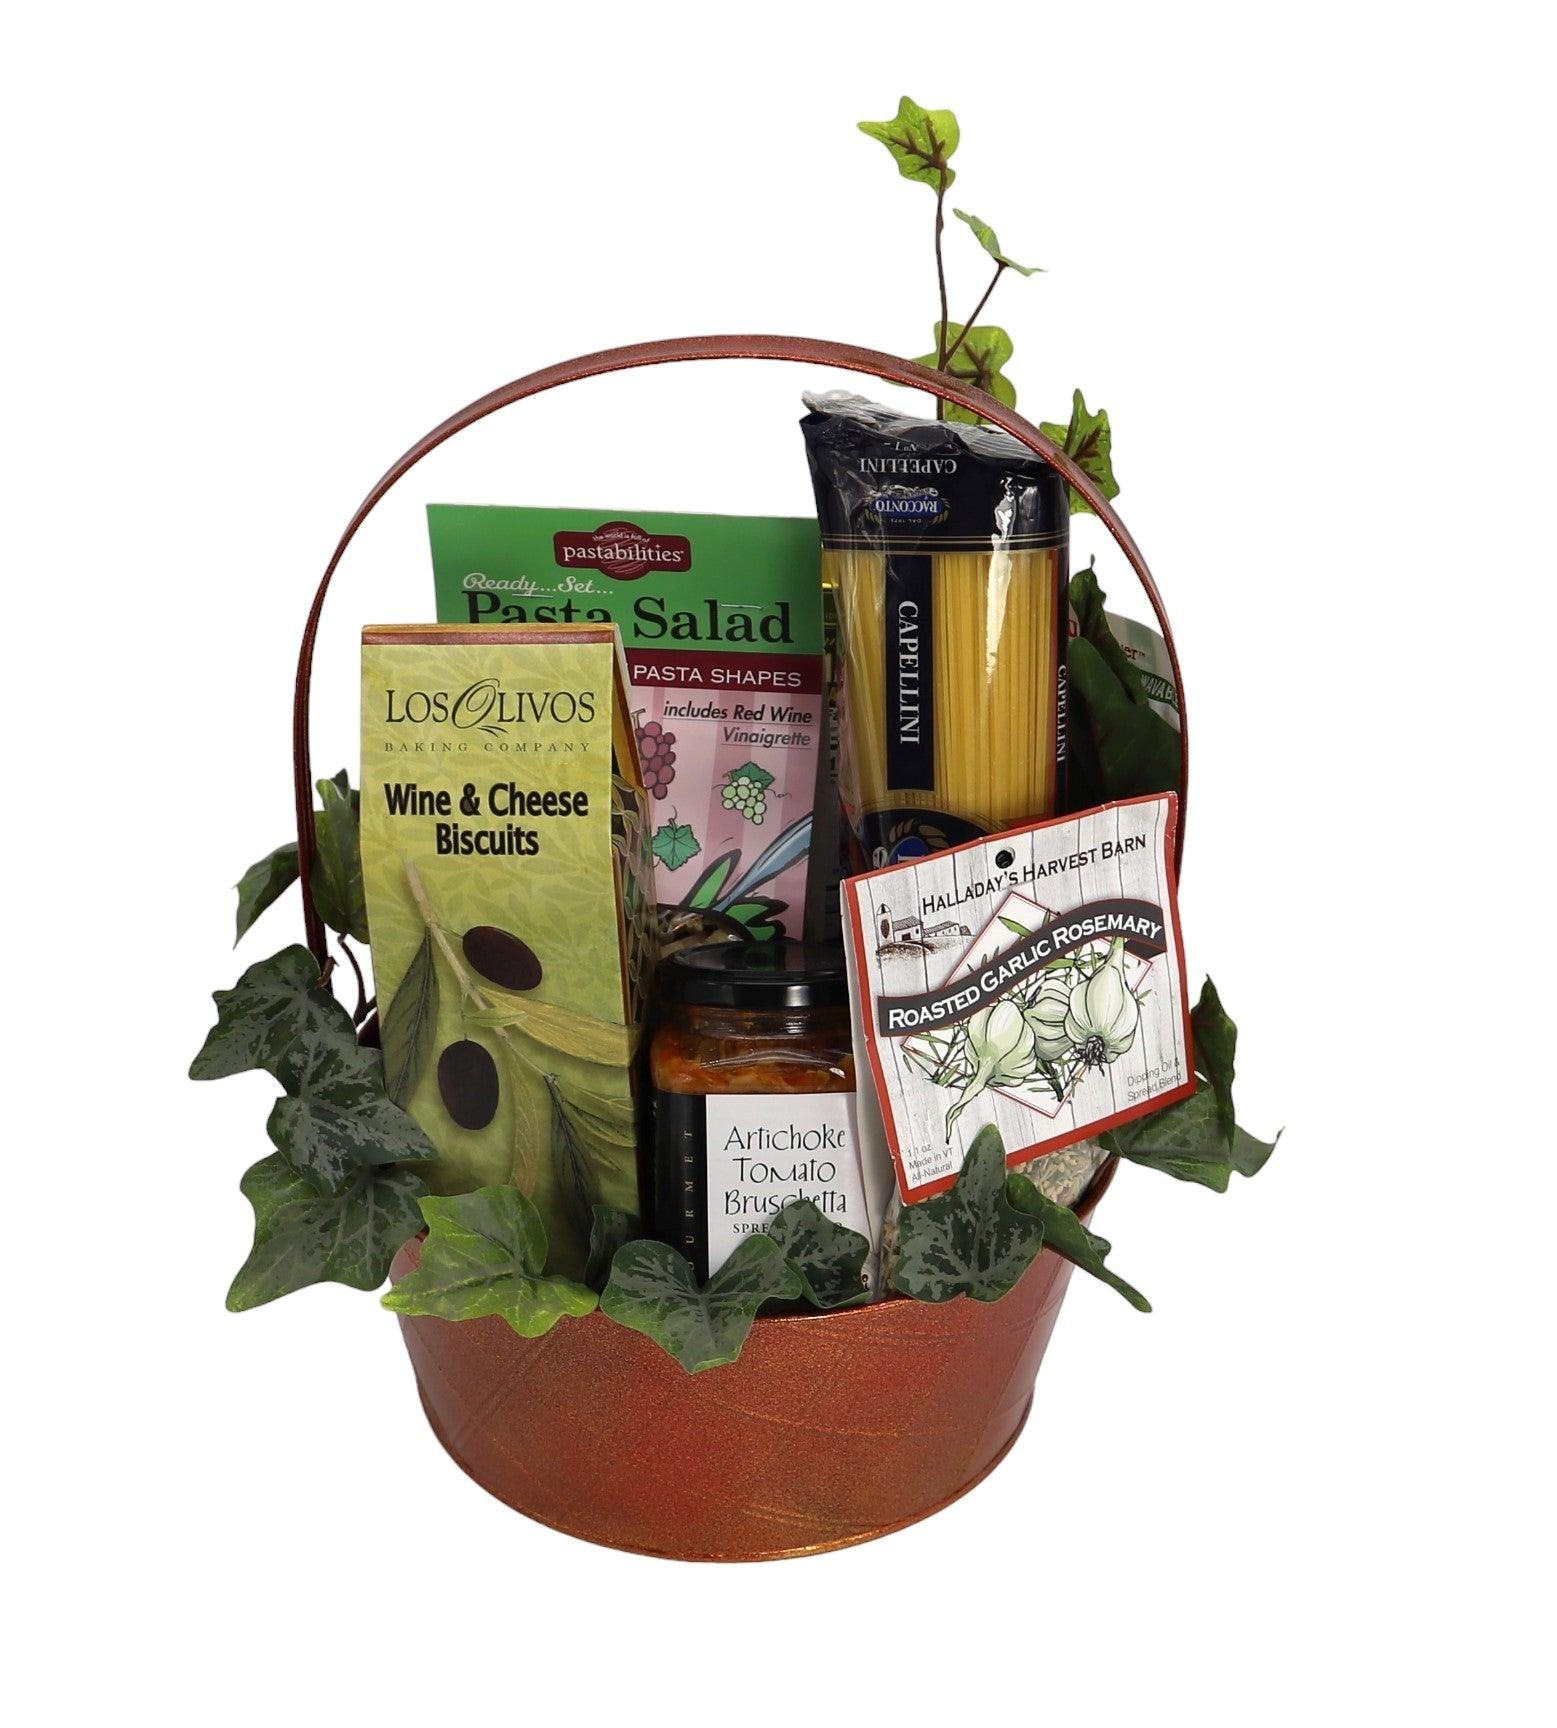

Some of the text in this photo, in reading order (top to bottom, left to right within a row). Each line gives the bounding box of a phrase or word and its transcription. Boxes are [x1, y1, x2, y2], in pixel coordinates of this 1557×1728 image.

[859, 458, 958, 474] CAPELLINI
[875, 500, 938, 514] RACCONTO
[563, 543, 682, 562] pastabilities
[633, 596, 795, 644] Salad
[633, 665, 801, 687] PASTA SHAPES
[898, 600, 920, 744] CAPELLINI
[663, 700, 813, 724] includes Red Wine
[1057, 664, 1066, 762] CAPELLINI
[385, 742, 590, 752] BAKING COMPANY
[723, 726, 811, 748] Vinaigrette
[384, 782, 589, 817] Wine & Cheese
[436, 823, 539, 856] Biscuits
[922, 834, 1146, 915] HALLADAY'S HARVEST BARN
[888, 913, 1162, 1029] ROASTED GARLIC ROSEMARY
[1127, 1067, 1160, 1087] Dipping
[1128, 1071, 1182, 1102] Spread Blend
[723, 1123, 846, 1151] Artichoke
[909, 1157, 932, 1169] Made
[943, 1147, 954, 1158] VT
[733, 1223, 769, 1234] SPRE
